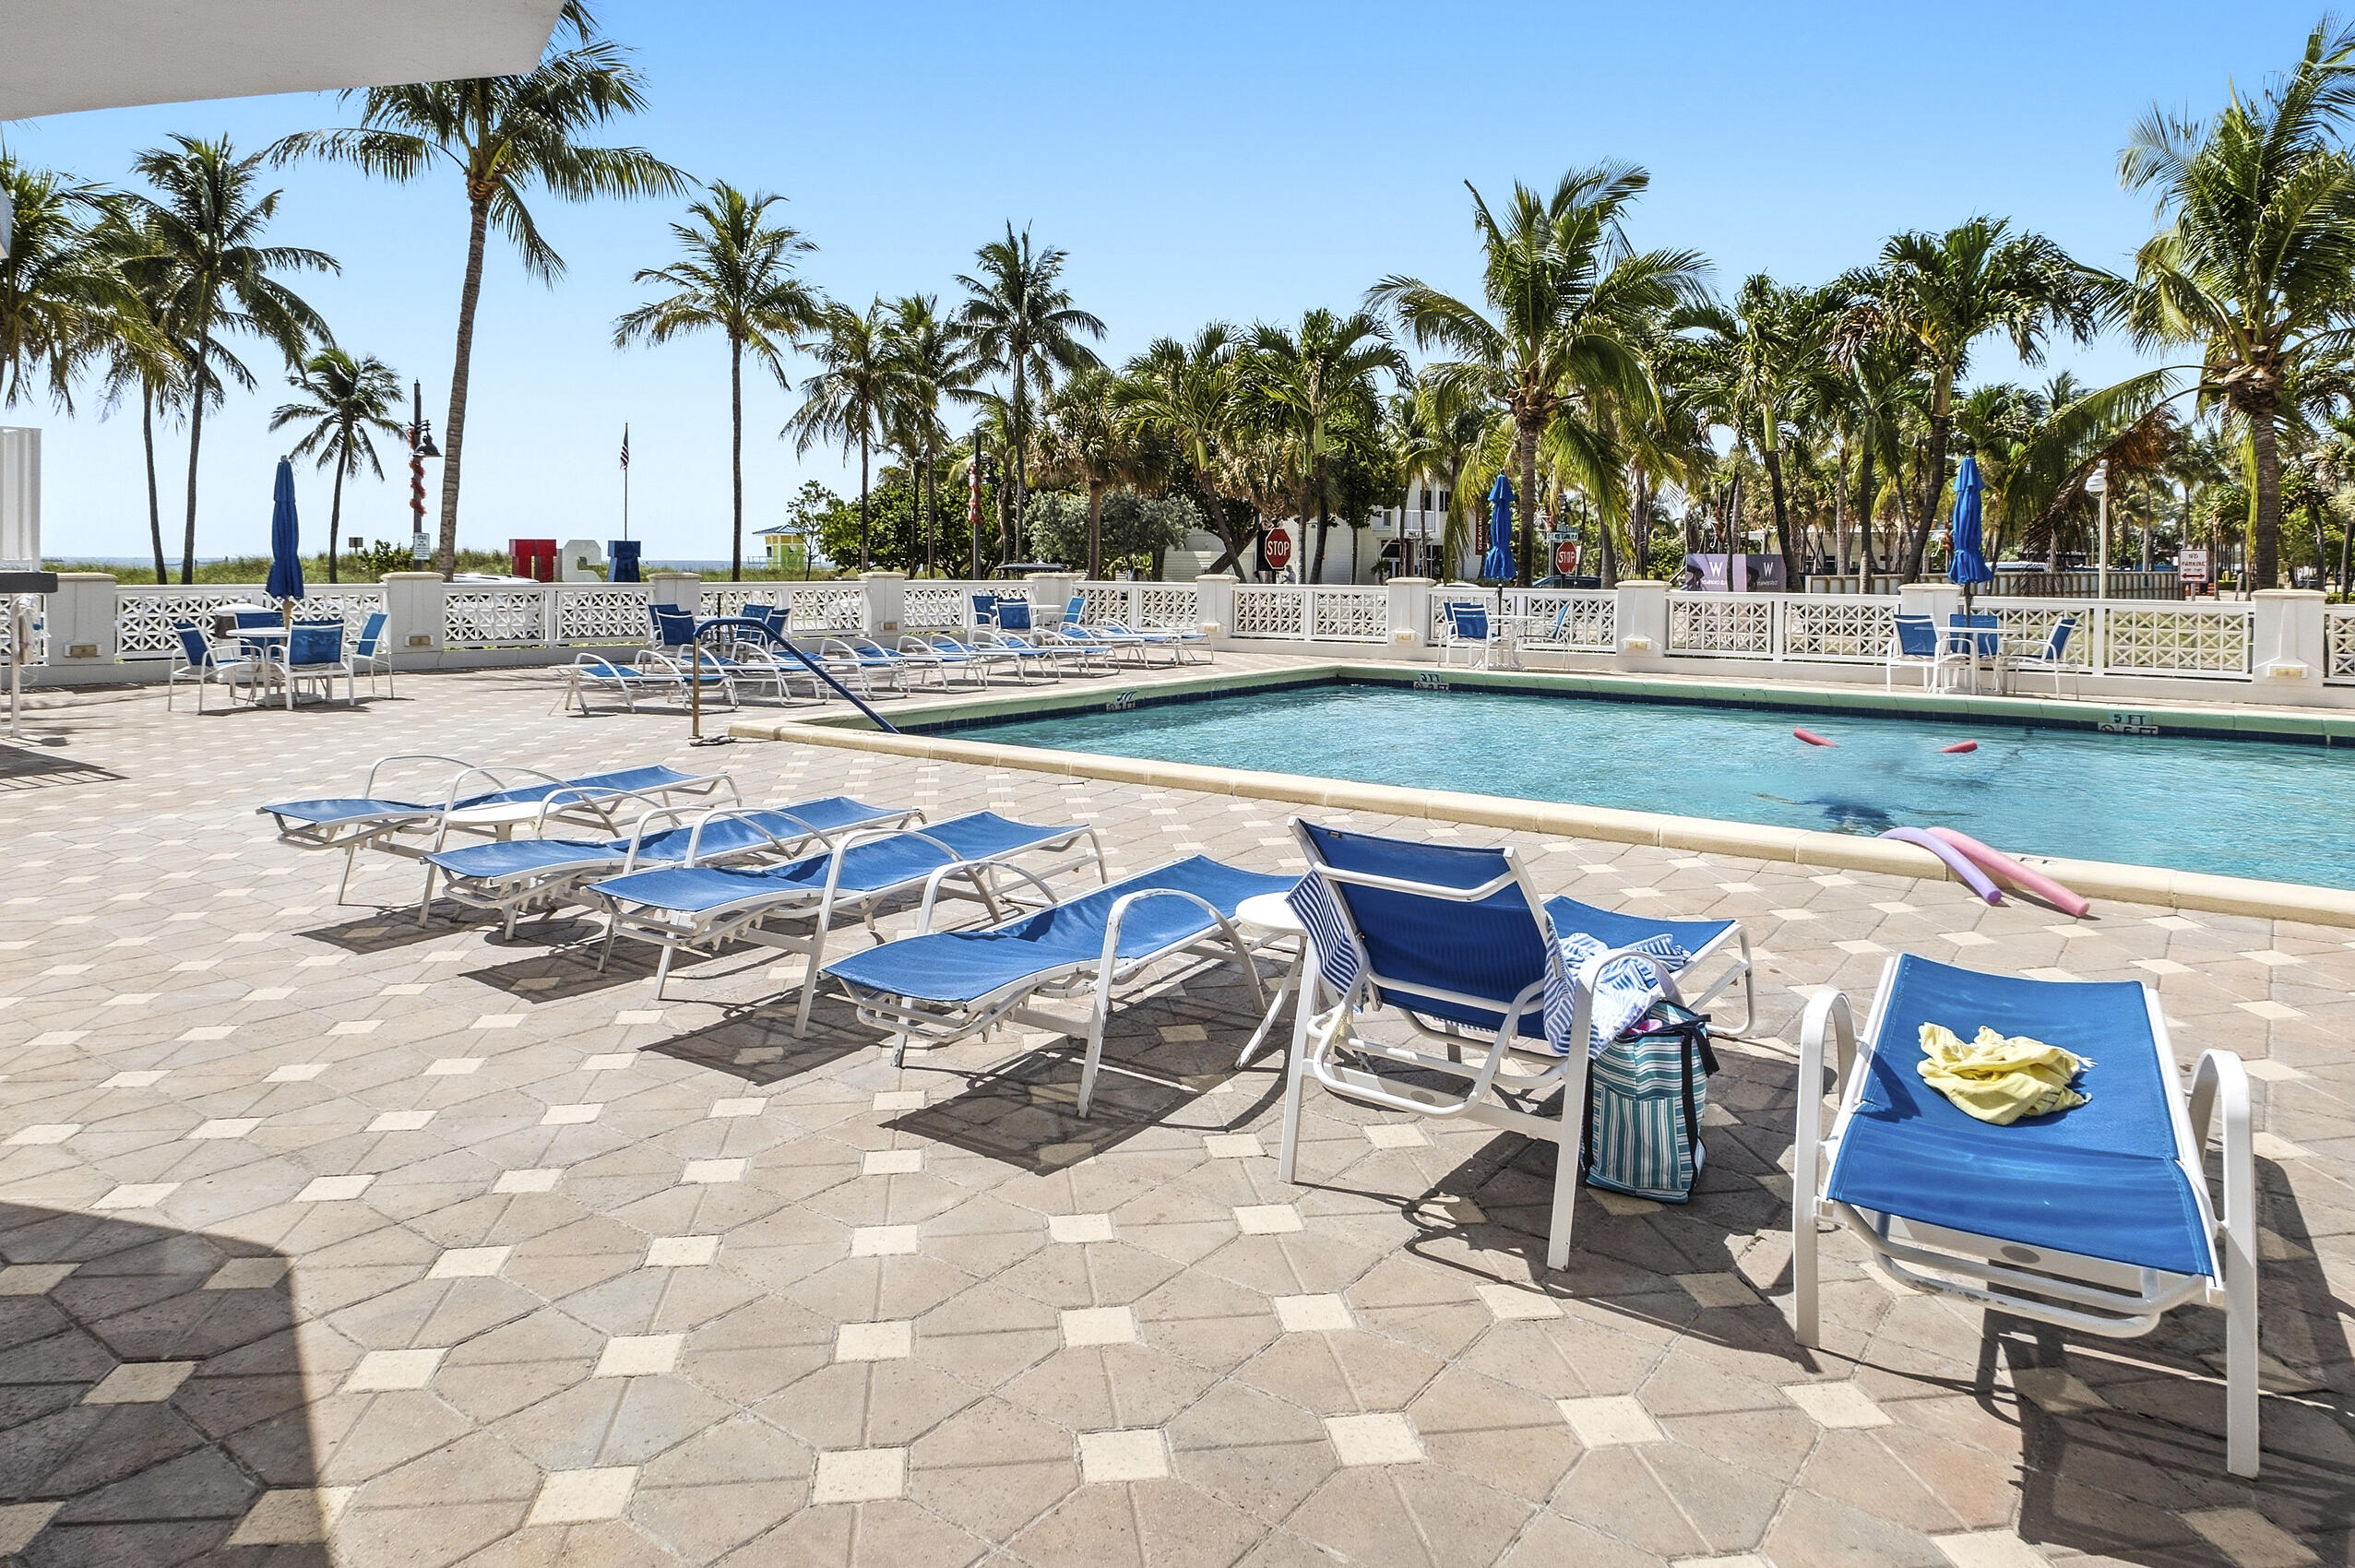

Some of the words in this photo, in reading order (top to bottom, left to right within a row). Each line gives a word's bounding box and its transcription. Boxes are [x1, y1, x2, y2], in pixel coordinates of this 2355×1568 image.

[1267, 540, 1290, 555] STOP
[1557, 551, 1576, 563] STOP
[1709, 561, 1723, 576] W
[1763, 561, 1774, 577] W
[2113, 713, 2122, 723] 5
[2127, 714, 2147, 725] FT
